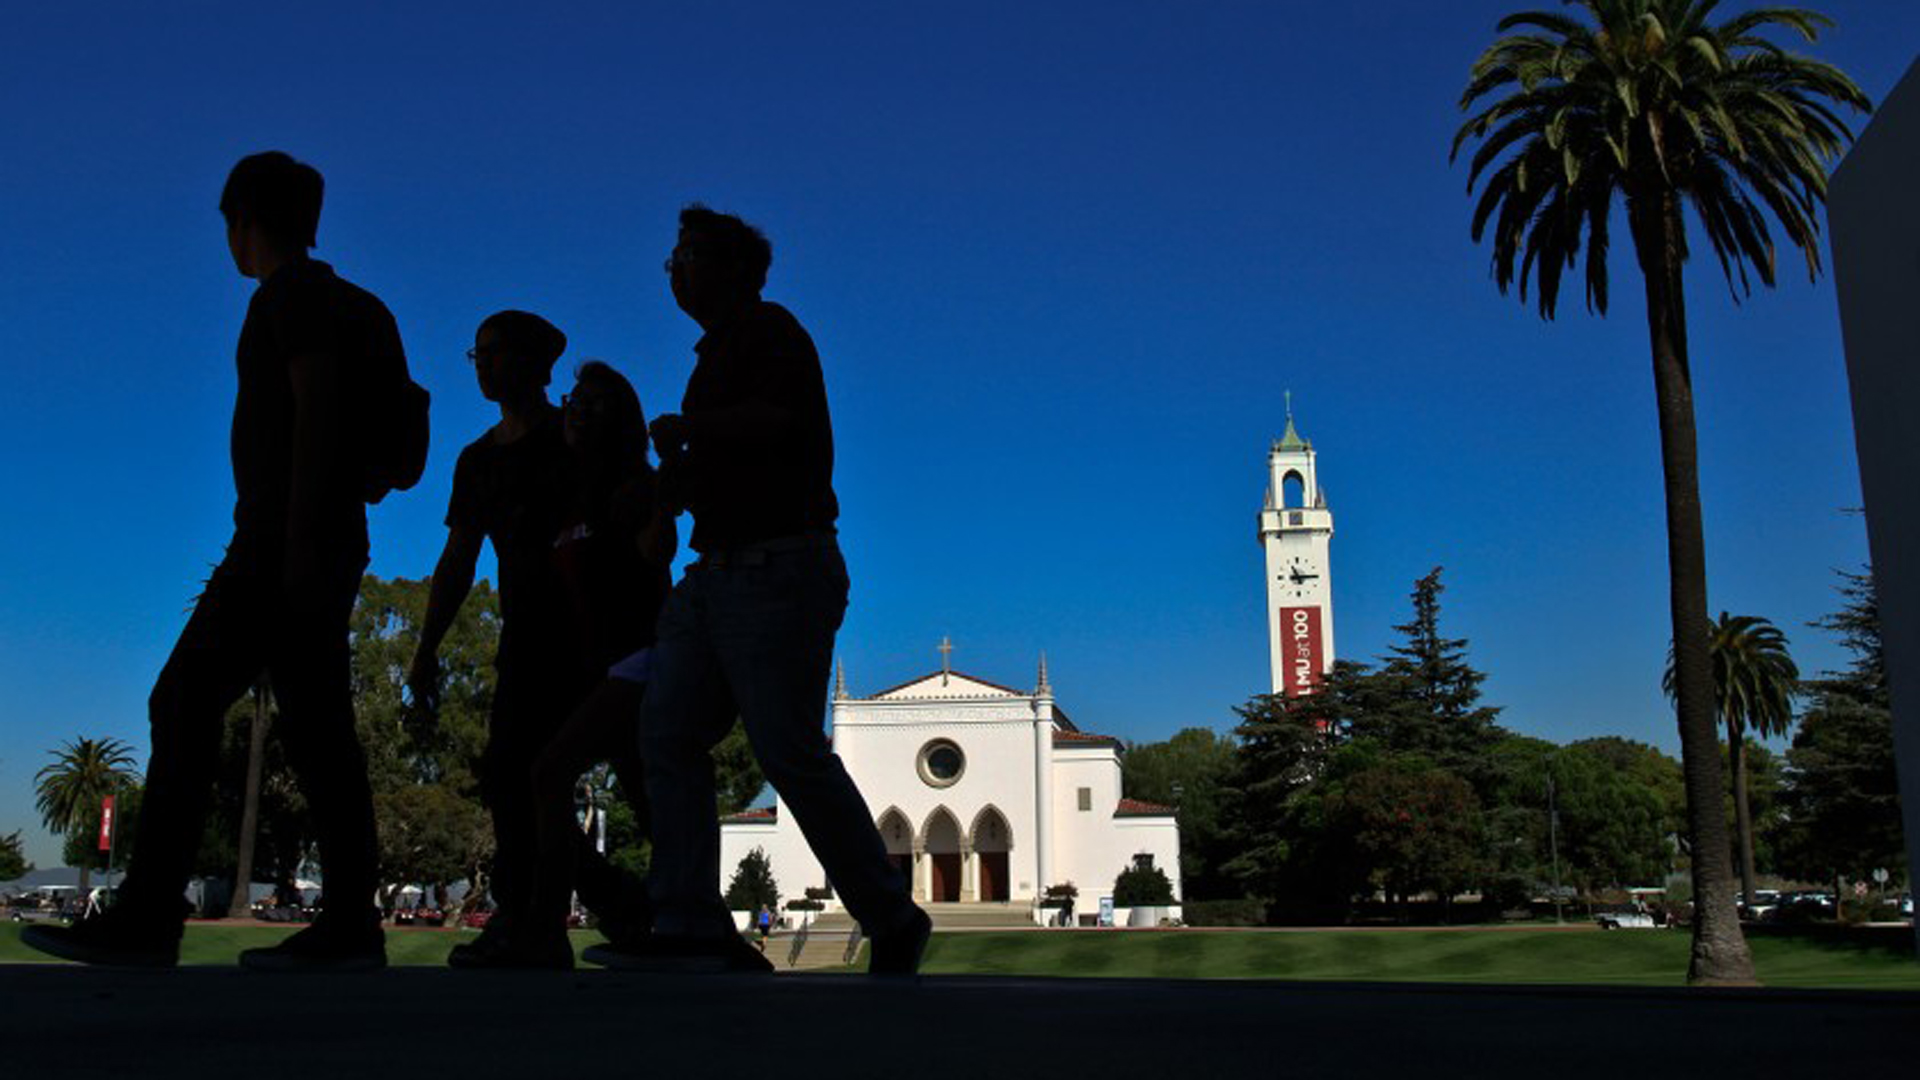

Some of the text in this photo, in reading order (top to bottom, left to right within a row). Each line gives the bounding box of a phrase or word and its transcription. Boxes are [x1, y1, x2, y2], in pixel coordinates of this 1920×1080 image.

[1293, 610, 1311, 695] LMU at 100
